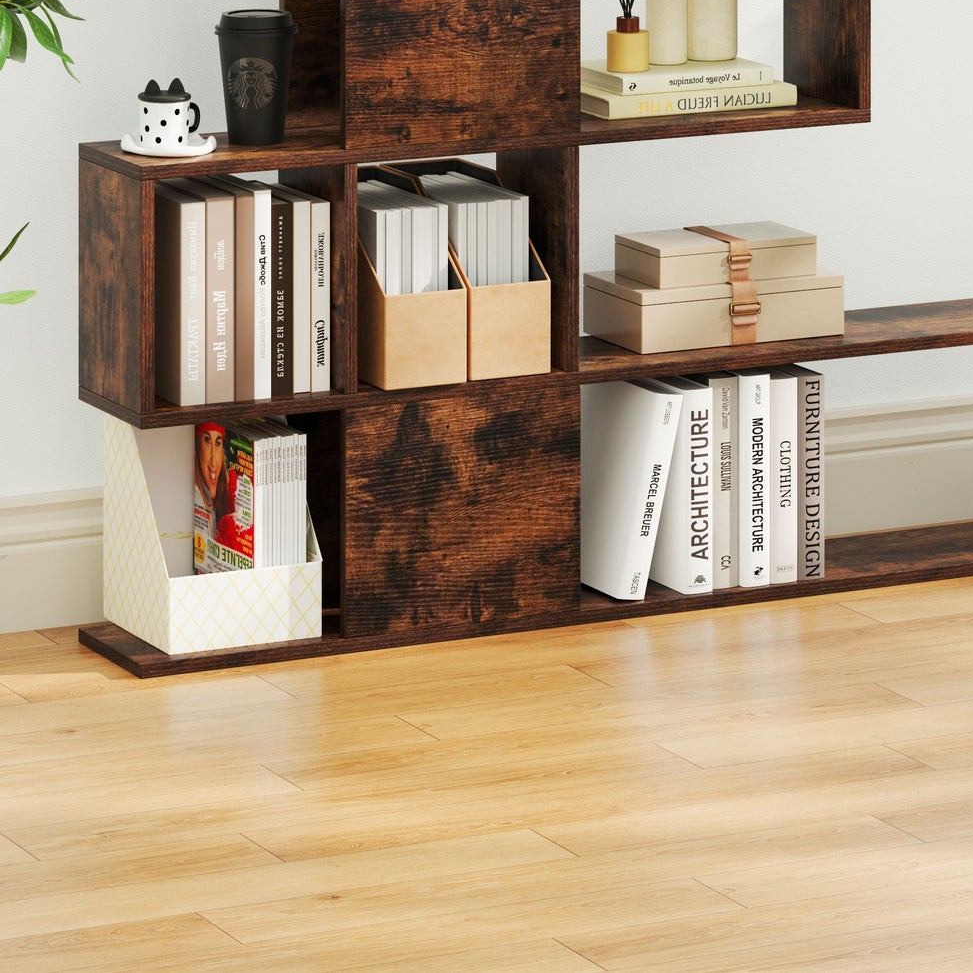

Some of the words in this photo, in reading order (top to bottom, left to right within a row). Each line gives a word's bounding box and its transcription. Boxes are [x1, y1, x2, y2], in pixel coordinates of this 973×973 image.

[720, 441, 731, 460] LOUIS
[752, 417, 764, 465] MODERN
[805, 379, 820, 498] FURNITURE
[648, 464, 662, 499] MARCEL
[691, 409, 709, 560] ARCHITECTURE
[720, 461, 731, 492] SULLIVAN
[780, 441, 792, 509] CLOTHING
[640, 501, 655, 537] BREUER
[752, 468, 764, 553] ARCHITECTURE
[805, 504, 820, 578] DESIGN
